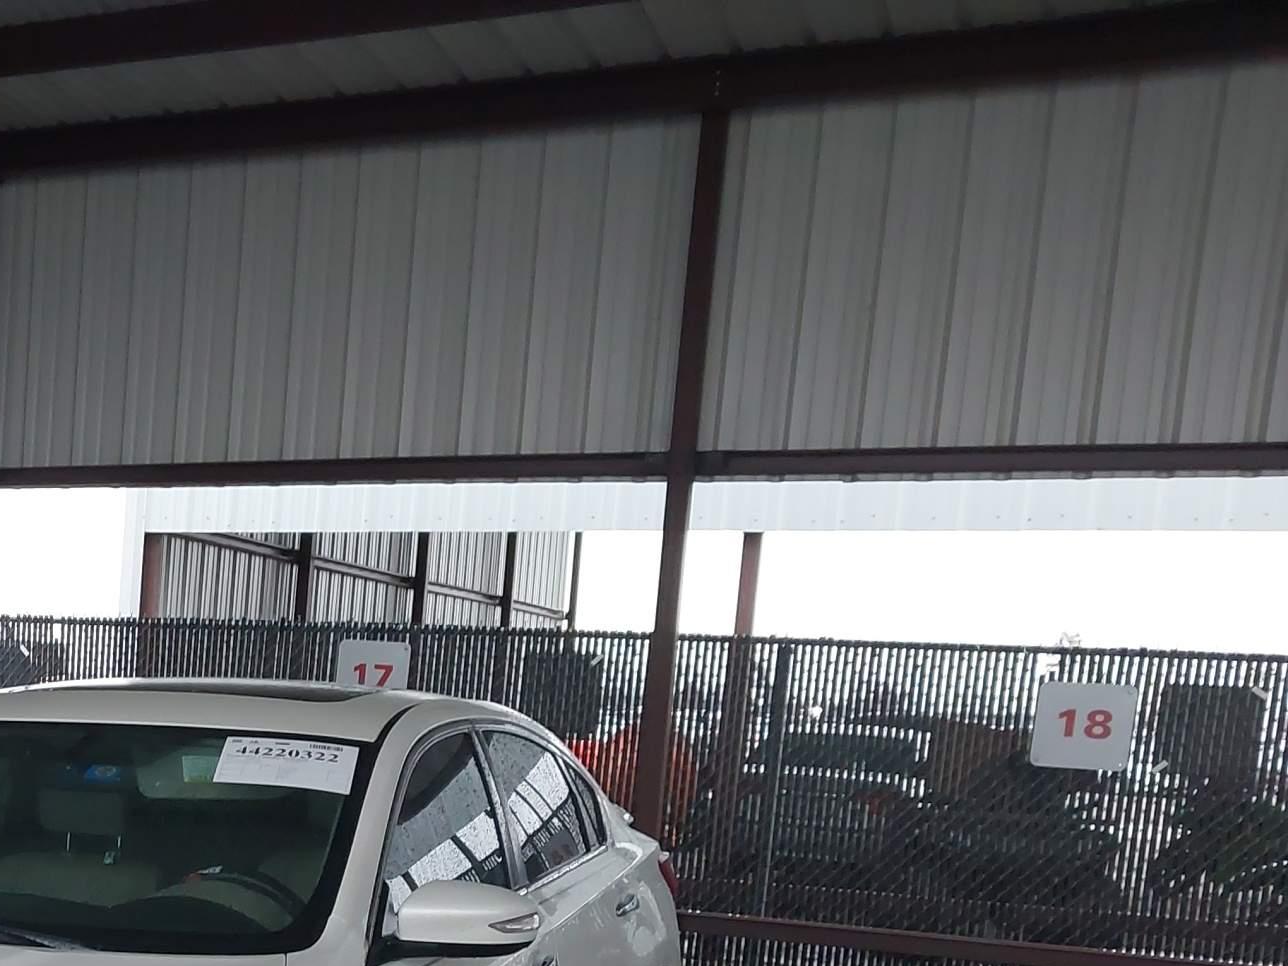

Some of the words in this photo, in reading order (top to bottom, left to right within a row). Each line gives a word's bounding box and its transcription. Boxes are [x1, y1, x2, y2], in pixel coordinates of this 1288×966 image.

[353, 663, 394, 688] 17
[1058, 708, 1113, 739] 18
[235, 745, 339, 763] 44220322
